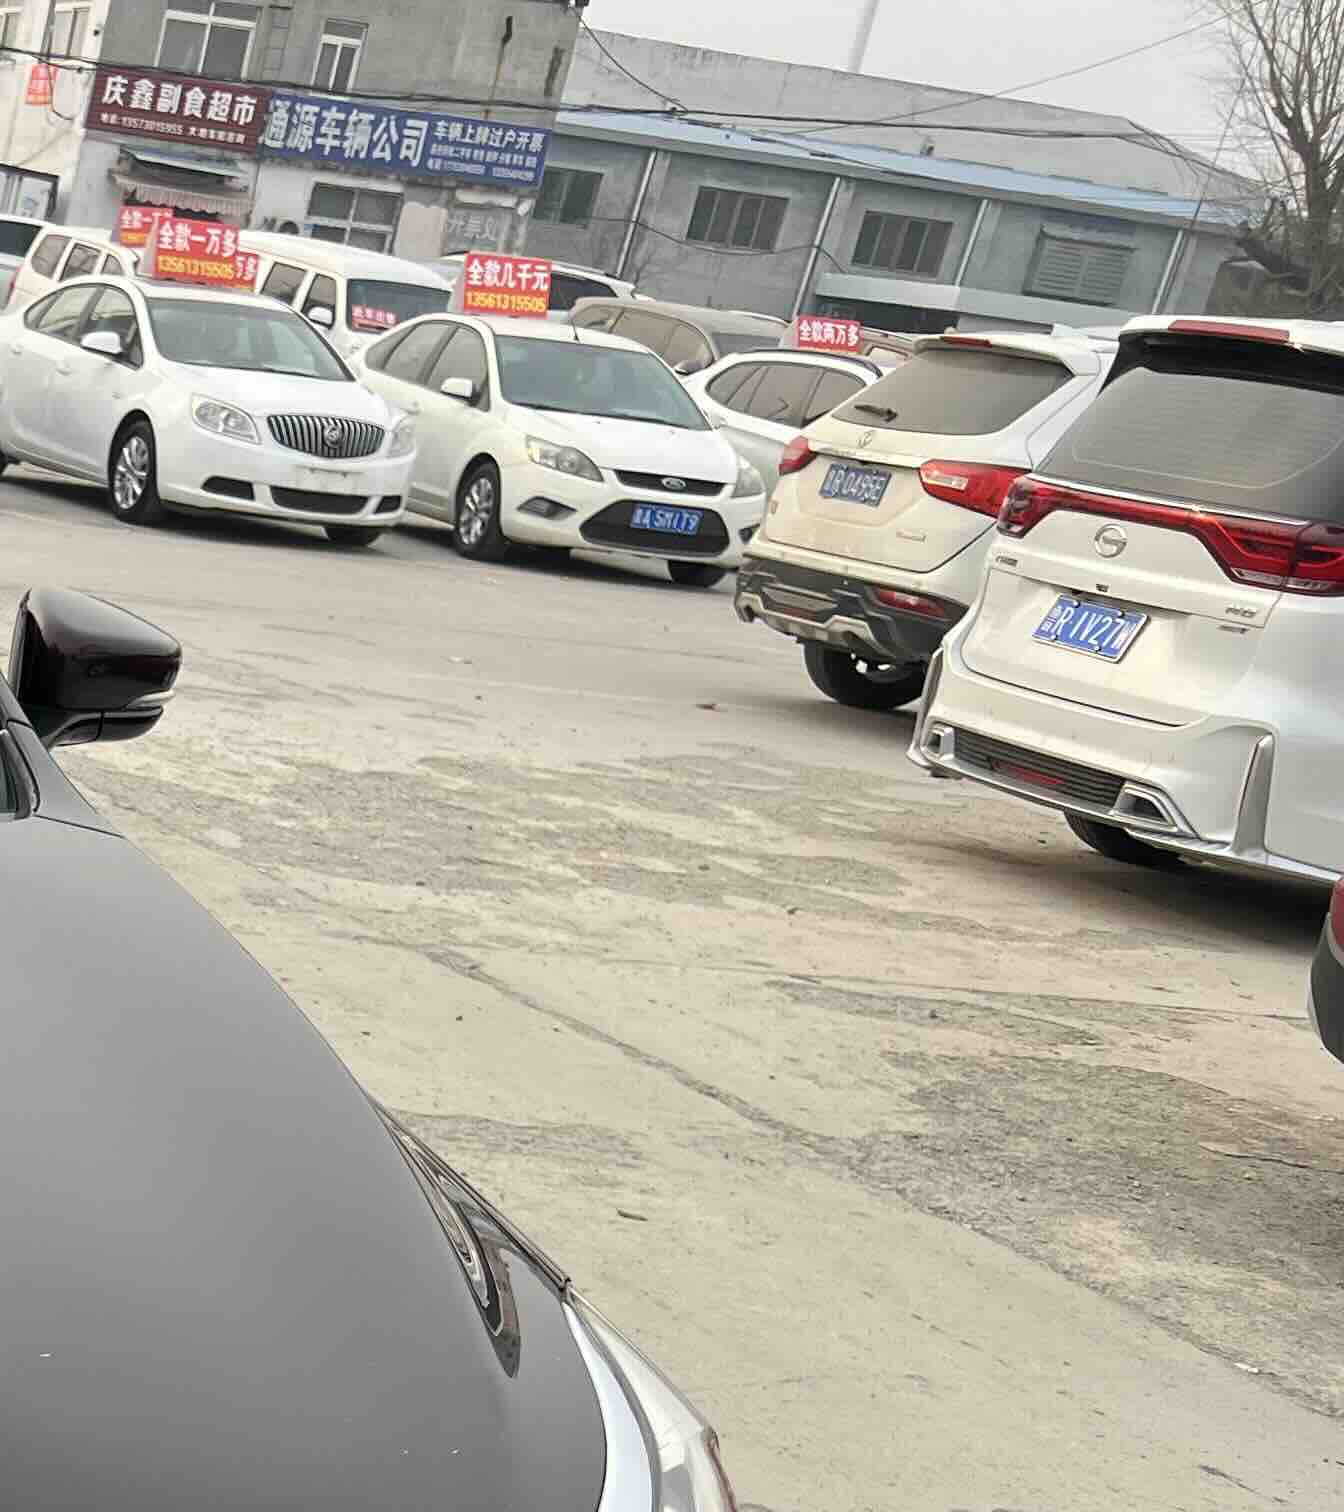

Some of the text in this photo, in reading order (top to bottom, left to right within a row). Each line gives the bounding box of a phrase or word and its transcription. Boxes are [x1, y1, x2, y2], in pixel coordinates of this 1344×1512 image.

[102, 75, 256, 126] 庆鑫副食超市
[259, 100, 428, 167] 通源车辆公司
[158, 220, 237, 258] 全款一万多
[467, 259, 549, 291] 全款几千元
[799, 319, 860, 347] 全款两万多
